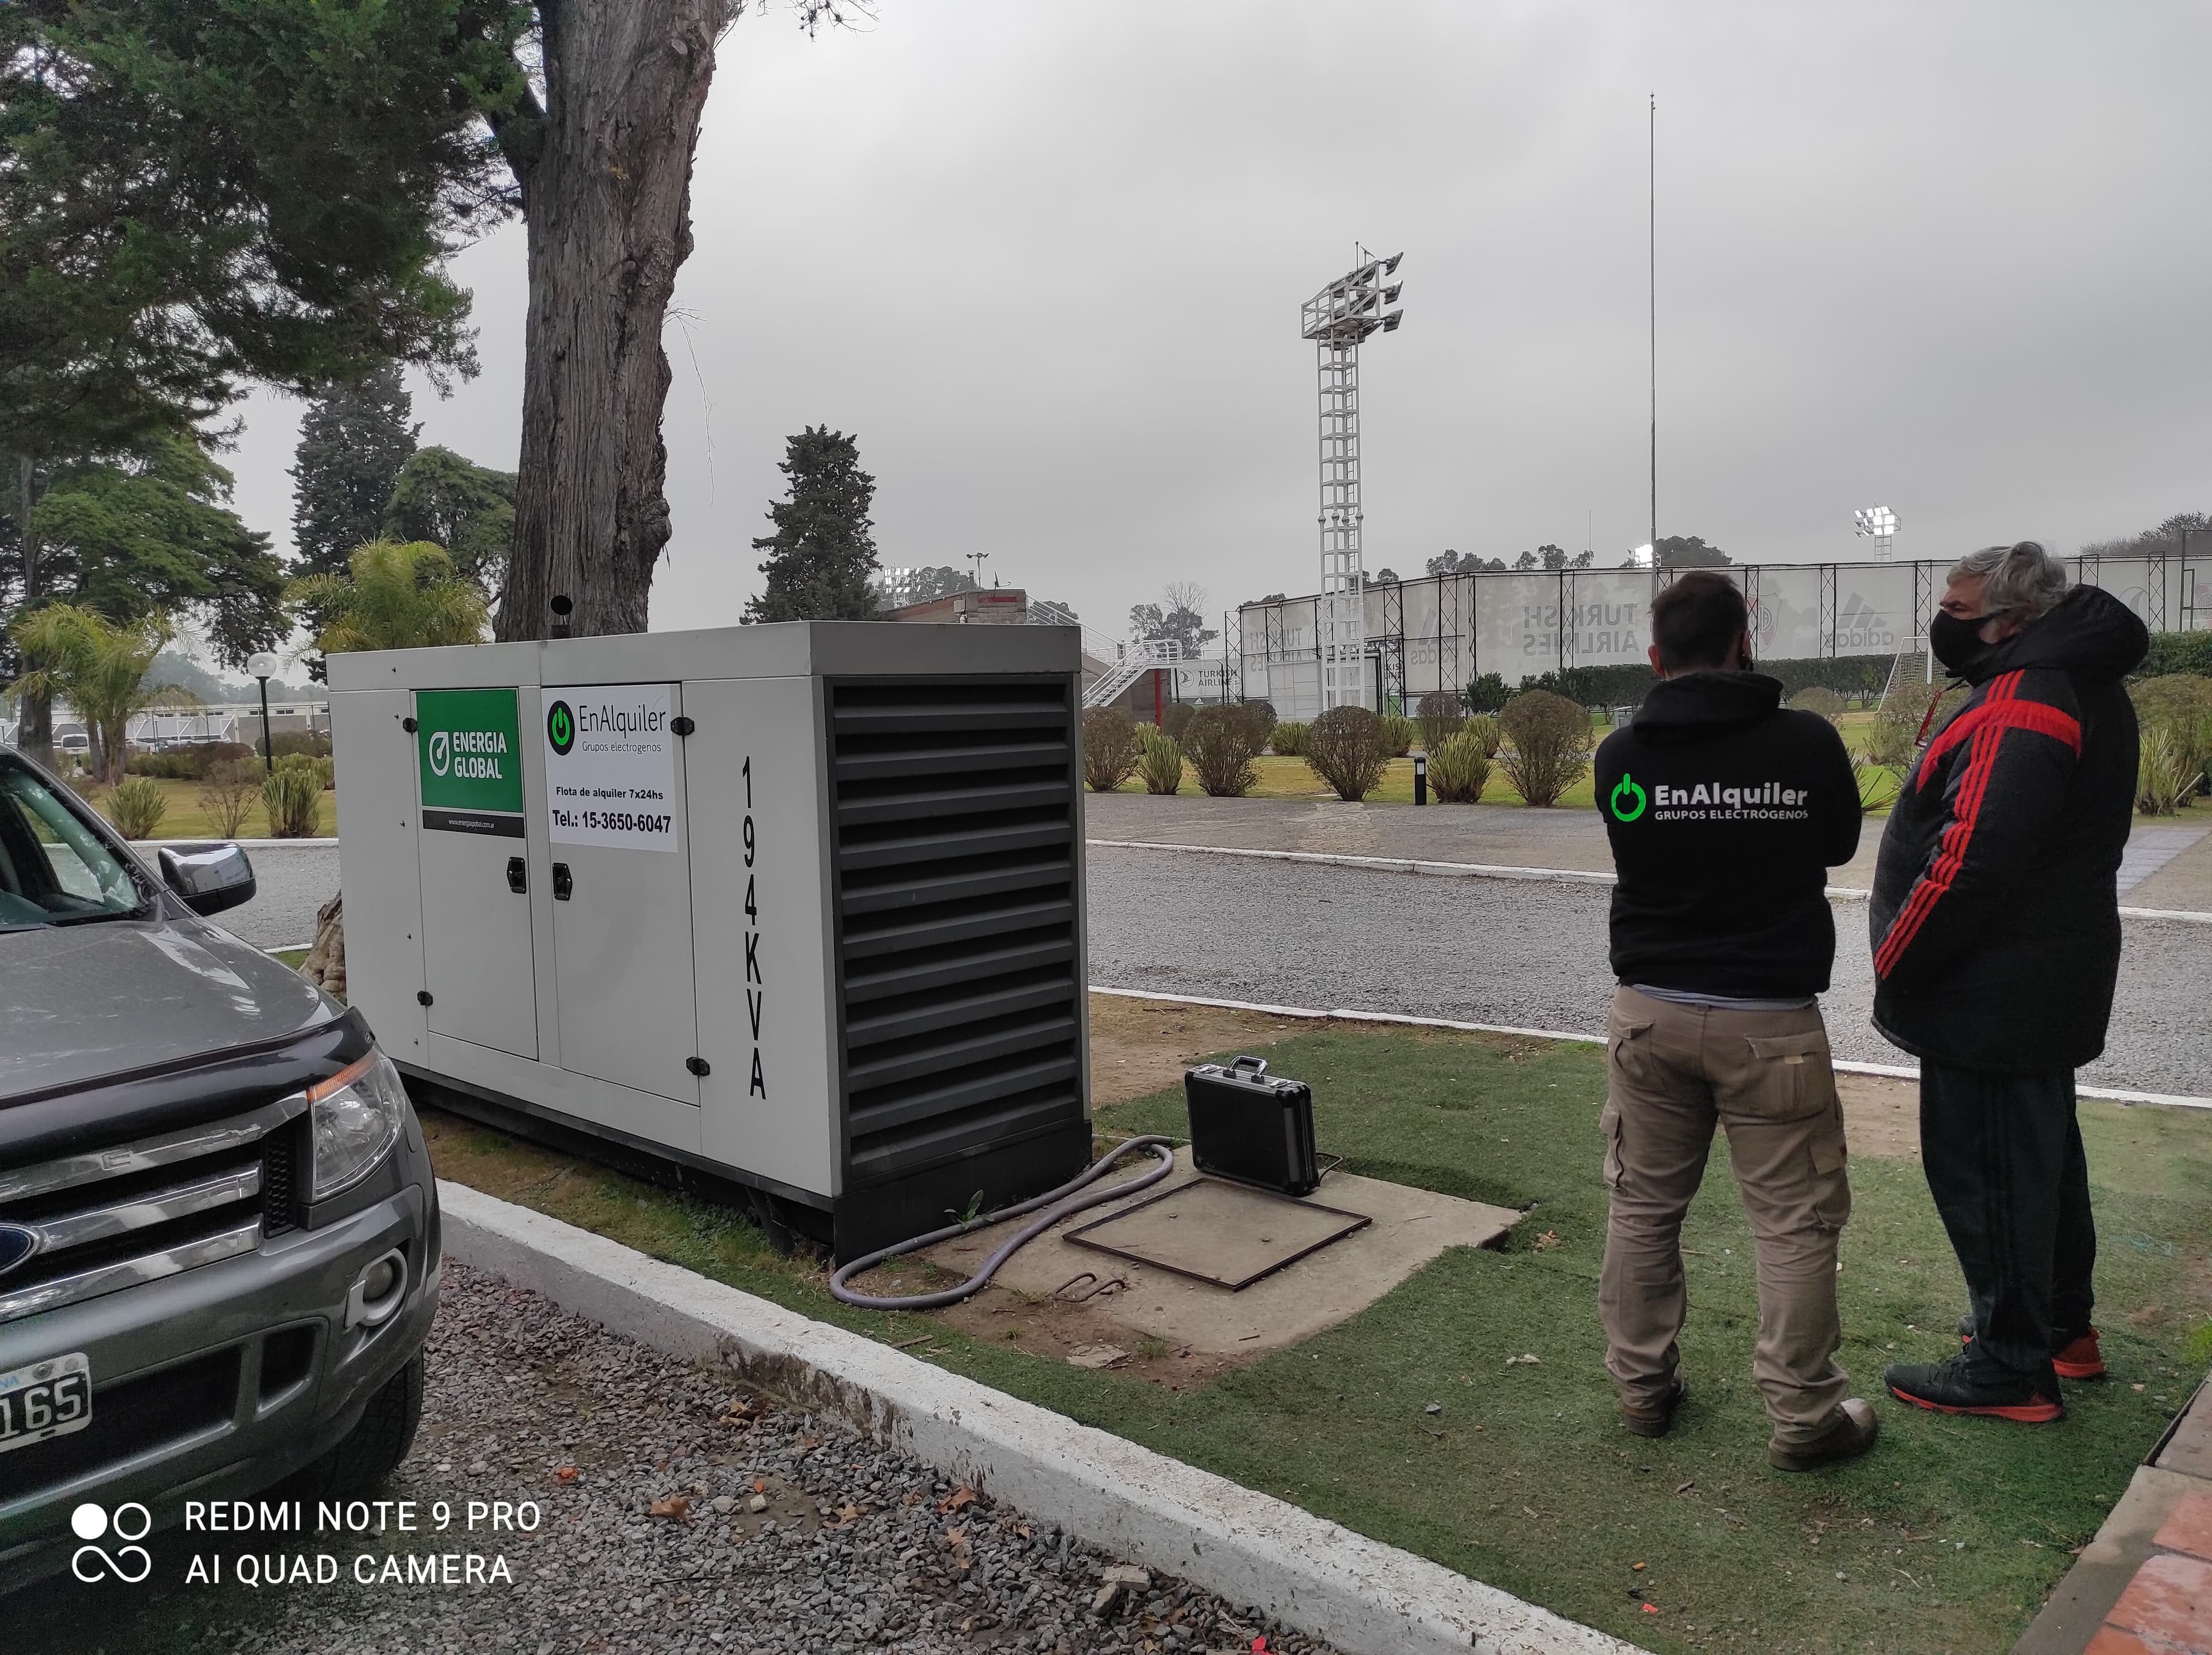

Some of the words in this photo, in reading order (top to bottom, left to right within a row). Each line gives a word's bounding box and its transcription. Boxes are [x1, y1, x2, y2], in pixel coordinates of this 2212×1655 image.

[579, 703, 666, 739] EnAlquiler
[453, 732, 507, 753] ENERGIA
[582, 741, 609, 753] Grupos
[611, 742, 661, 755] electrogenos
[454, 756, 502, 779] GLOBAL
[556, 786, 577, 796] Flota
[579, 787, 590, 797] de
[593, 788, 626, 800] alquiler
[628, 789, 664, 800] 7x24hs
[1654, 782, 1808, 809] EnAlquiler
[552, 809, 578, 828] Tel.:
[582, 811, 671, 834] 15-3650-6047
[1654, 809, 1706, 820] GRUPOS
[1710, 808, 1809, 820] ELECTRÓGENOS
